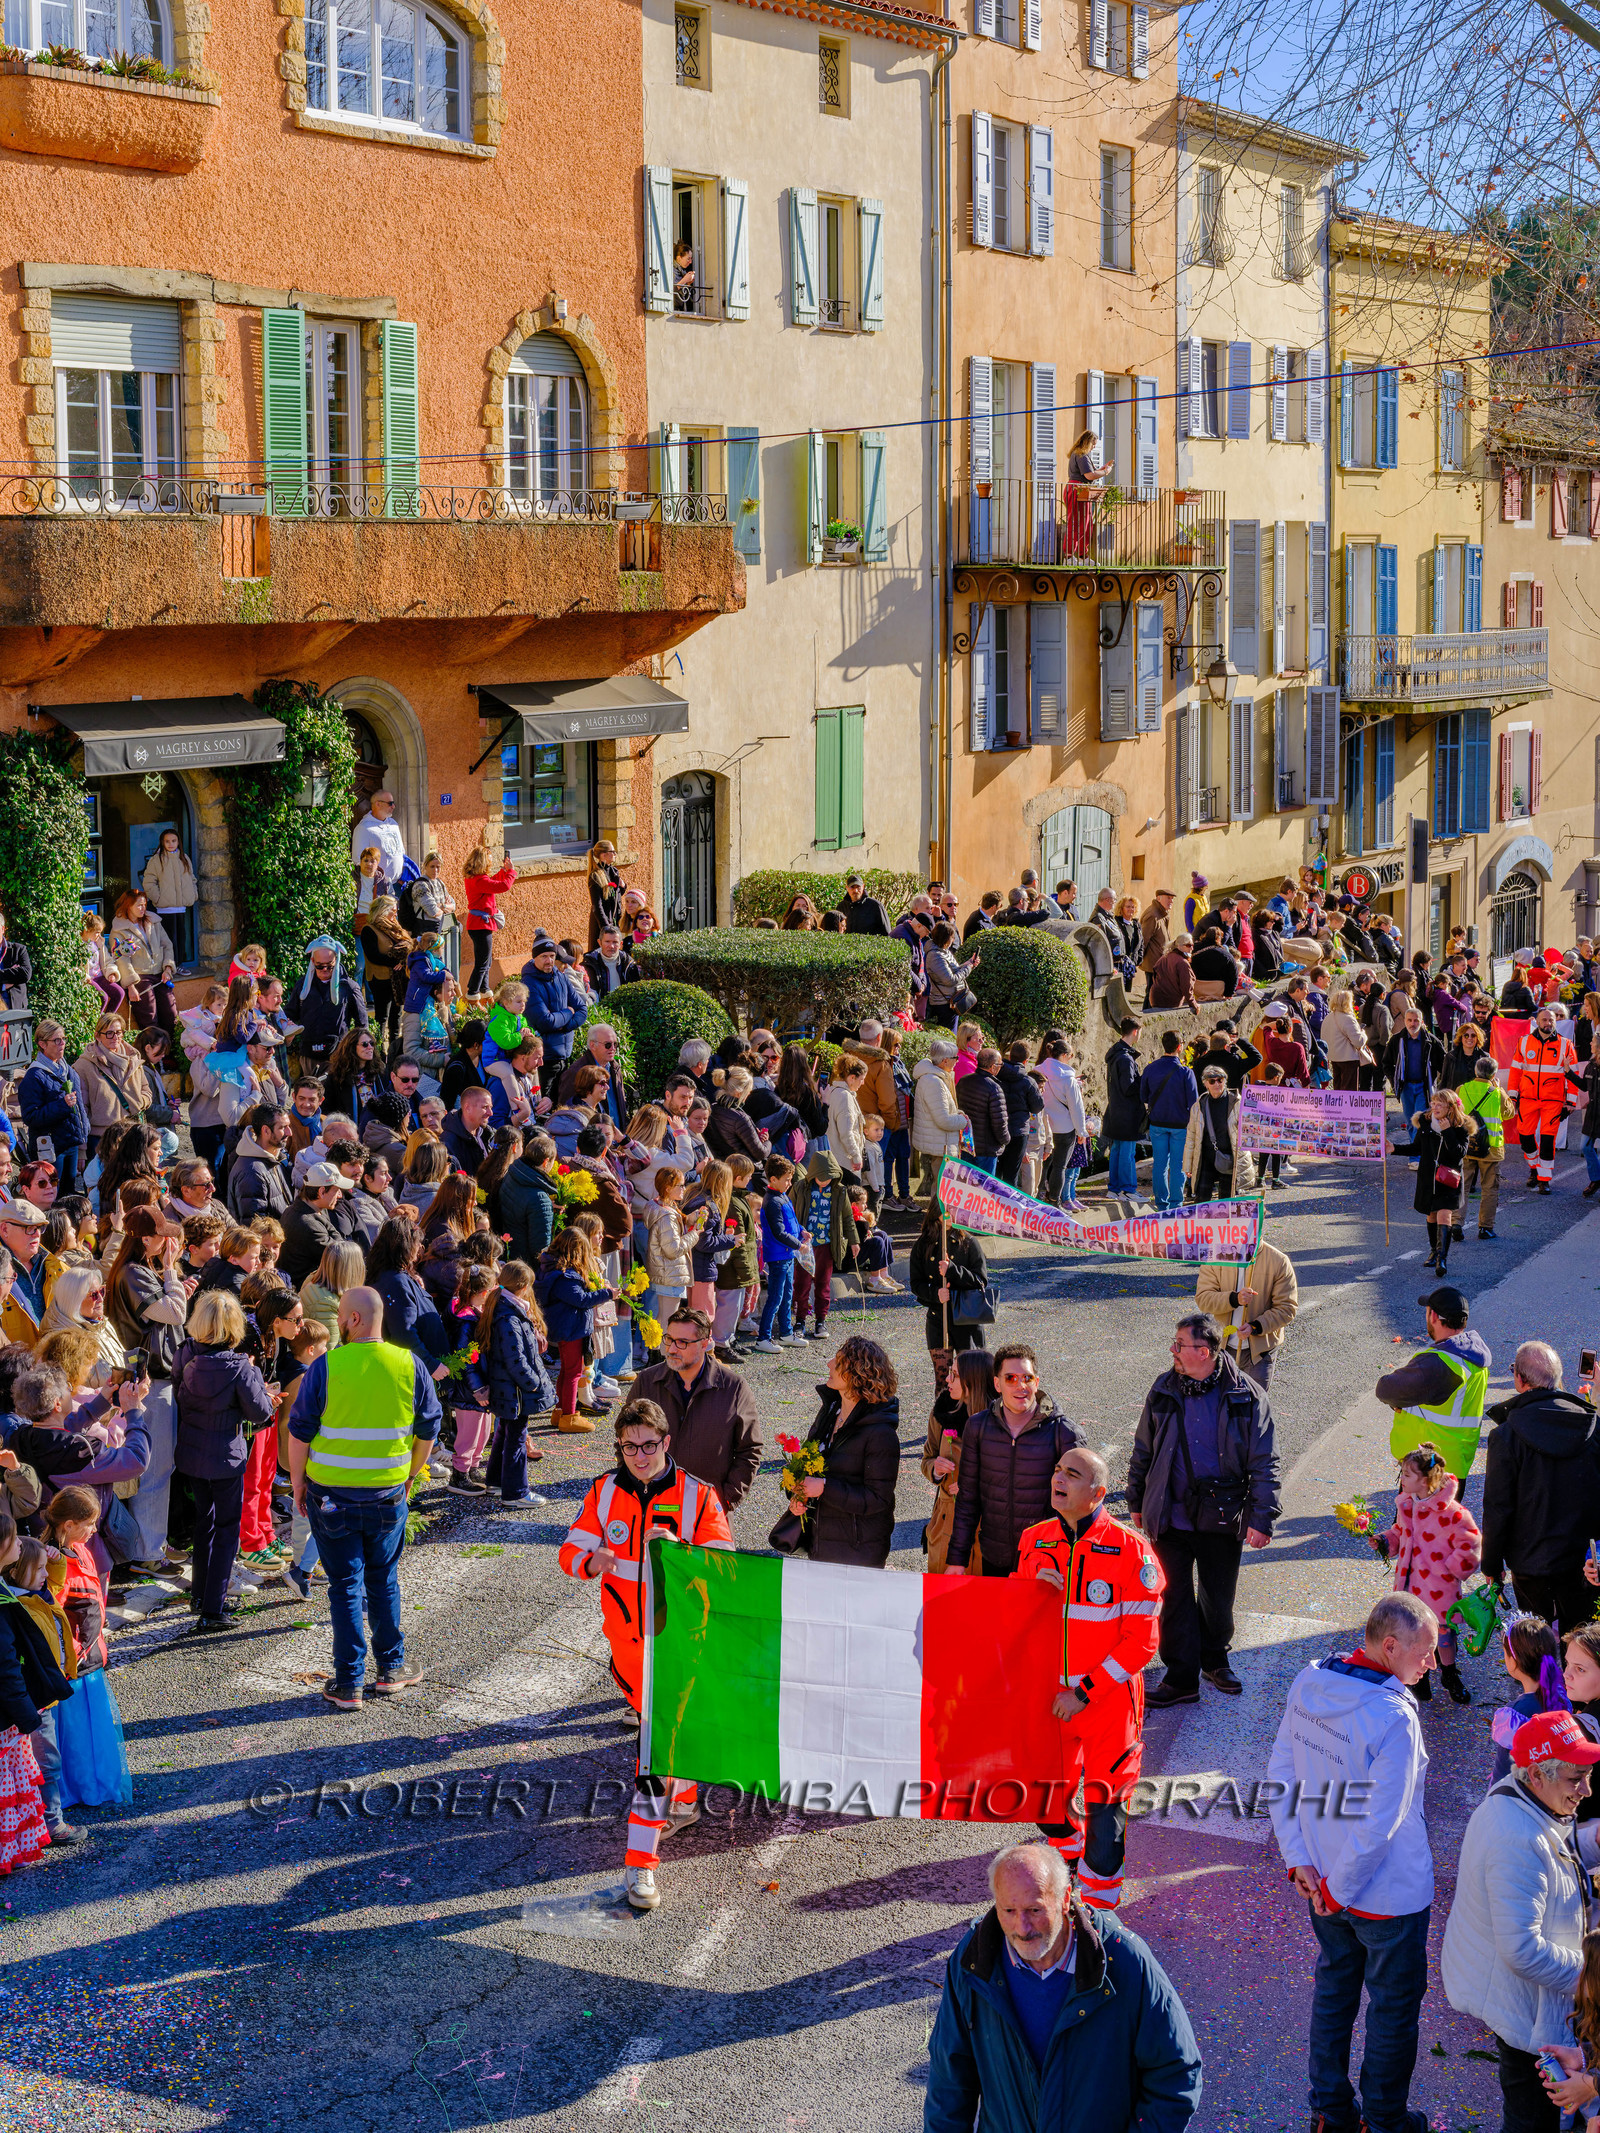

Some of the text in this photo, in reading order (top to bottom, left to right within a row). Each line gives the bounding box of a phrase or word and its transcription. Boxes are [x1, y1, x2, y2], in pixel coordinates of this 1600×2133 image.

[585, 713, 648, 728] MAGREY & SONS
[155, 738, 241, 756] MAGREY & SONS
[1353, 876, 1365, 895] B
[1245, 1089, 1285, 1105] Gemellagio
[1290, 1092, 1323, 1108] Jumelage
[1324, 1094, 1344, 1107] Marti
[1349, 1095, 1382, 1108] Valbonne
[939, 1177, 963, 1207] Nos
[964, 1193, 1019, 1226] ancêtres
[1021, 1207, 1070, 1238] italiens
[1083, 1225, 1119, 1242] leurs
[1124, 1219, 1160, 1244] 1000
[1164, 1220, 1180, 1245] et
[1184, 1219, 1214, 1245] Une
[1218, 1219, 1248, 1245] vies
[1294, 1731, 1301, 1742] de
[1550, 1719, 1571, 1736] MAKE
[1529, 1741, 1553, 1760] 45-47
